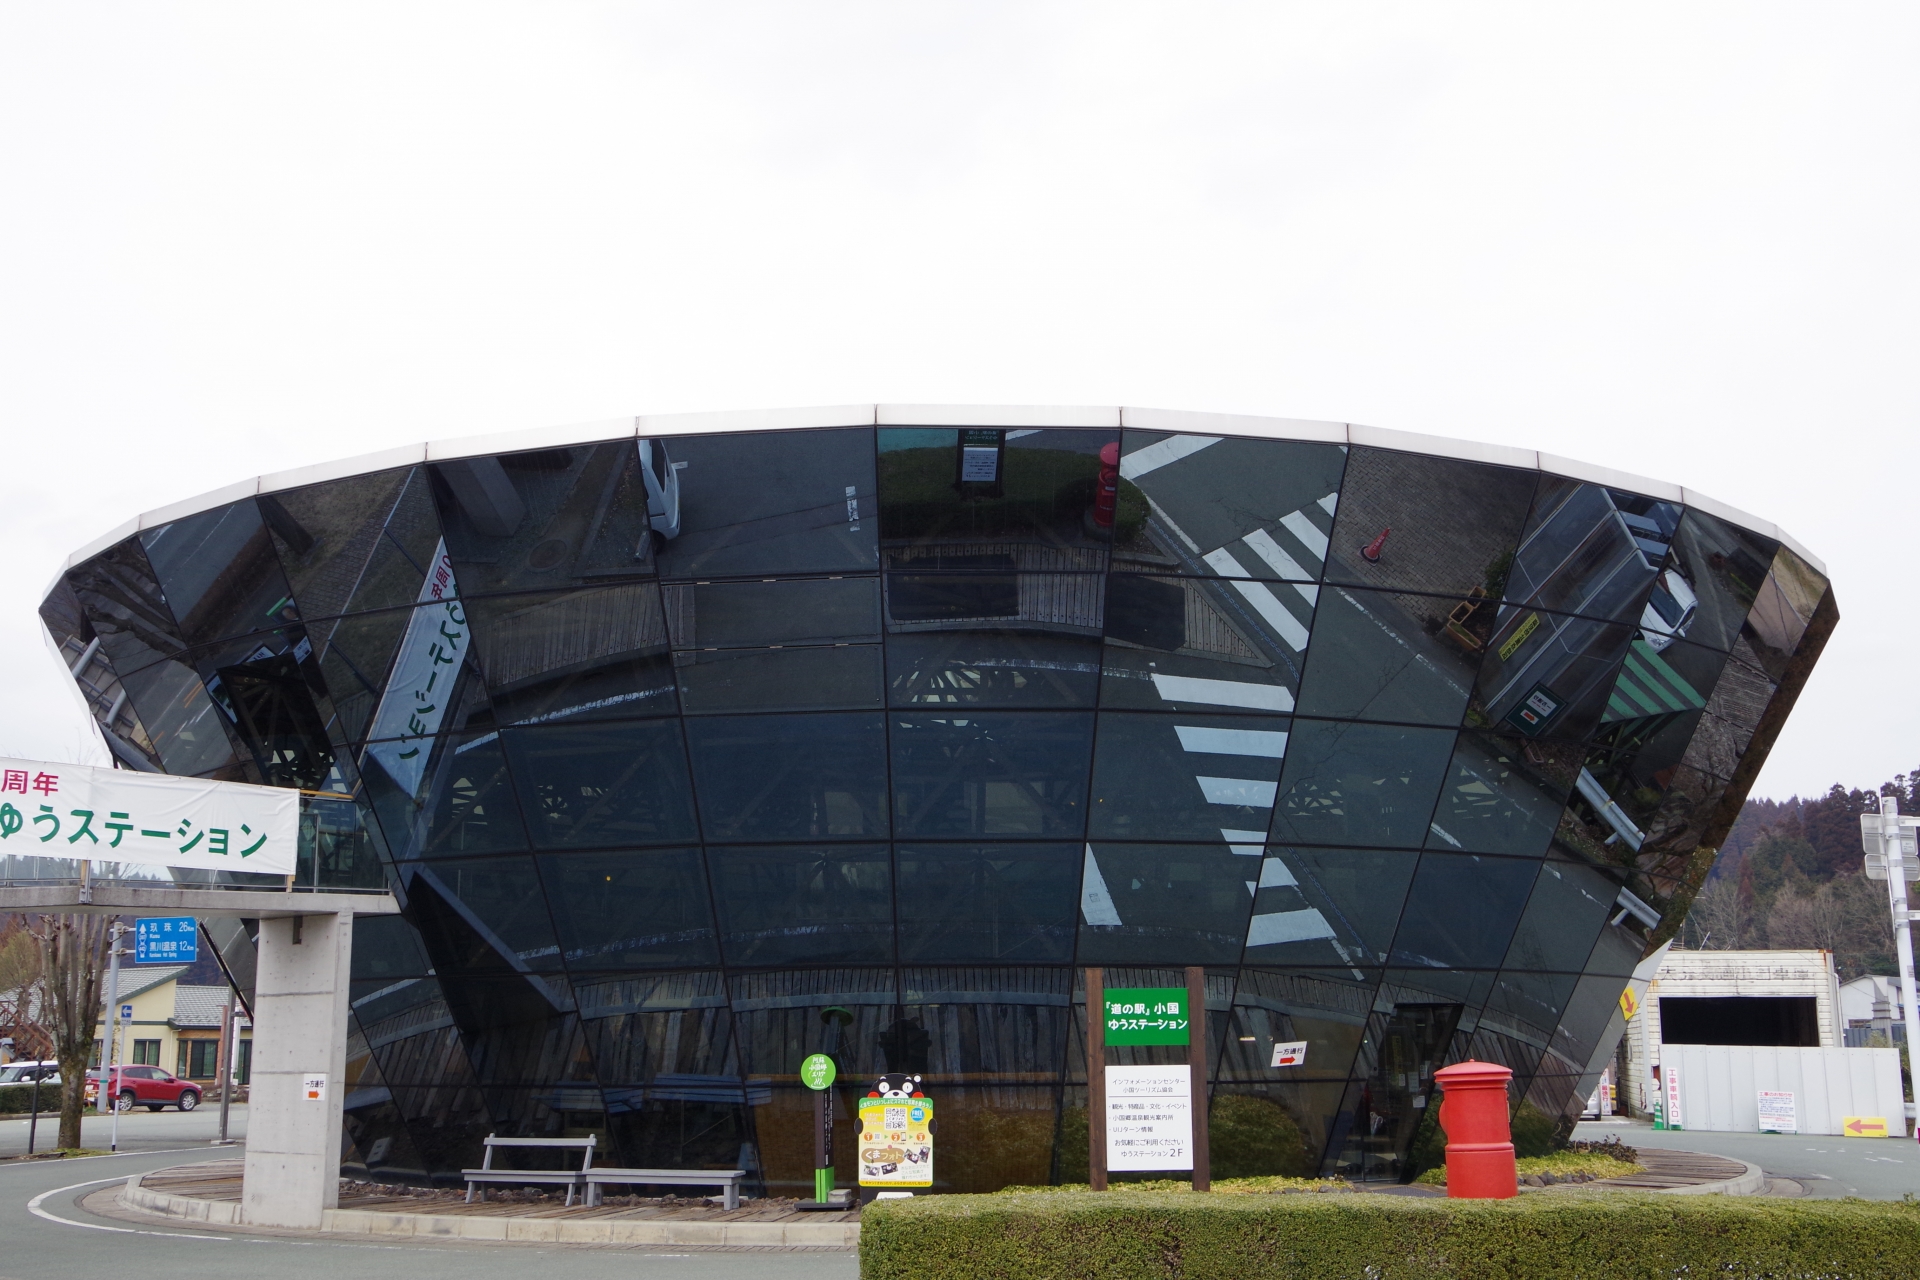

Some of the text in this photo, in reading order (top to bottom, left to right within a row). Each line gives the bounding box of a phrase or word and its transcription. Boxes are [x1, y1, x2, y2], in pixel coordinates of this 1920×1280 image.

[0, 769, 59, 797] 周年
[0, 802, 268, 859] ゆうステーション
[1108, 1018, 1188, 1031] ゆうステーション
[305, 1080, 325, 1088] 一方通行
[1114, 1138, 1184, 1147] お気軽にご利用ください
[865, 1149, 902, 1160] くまフォト
